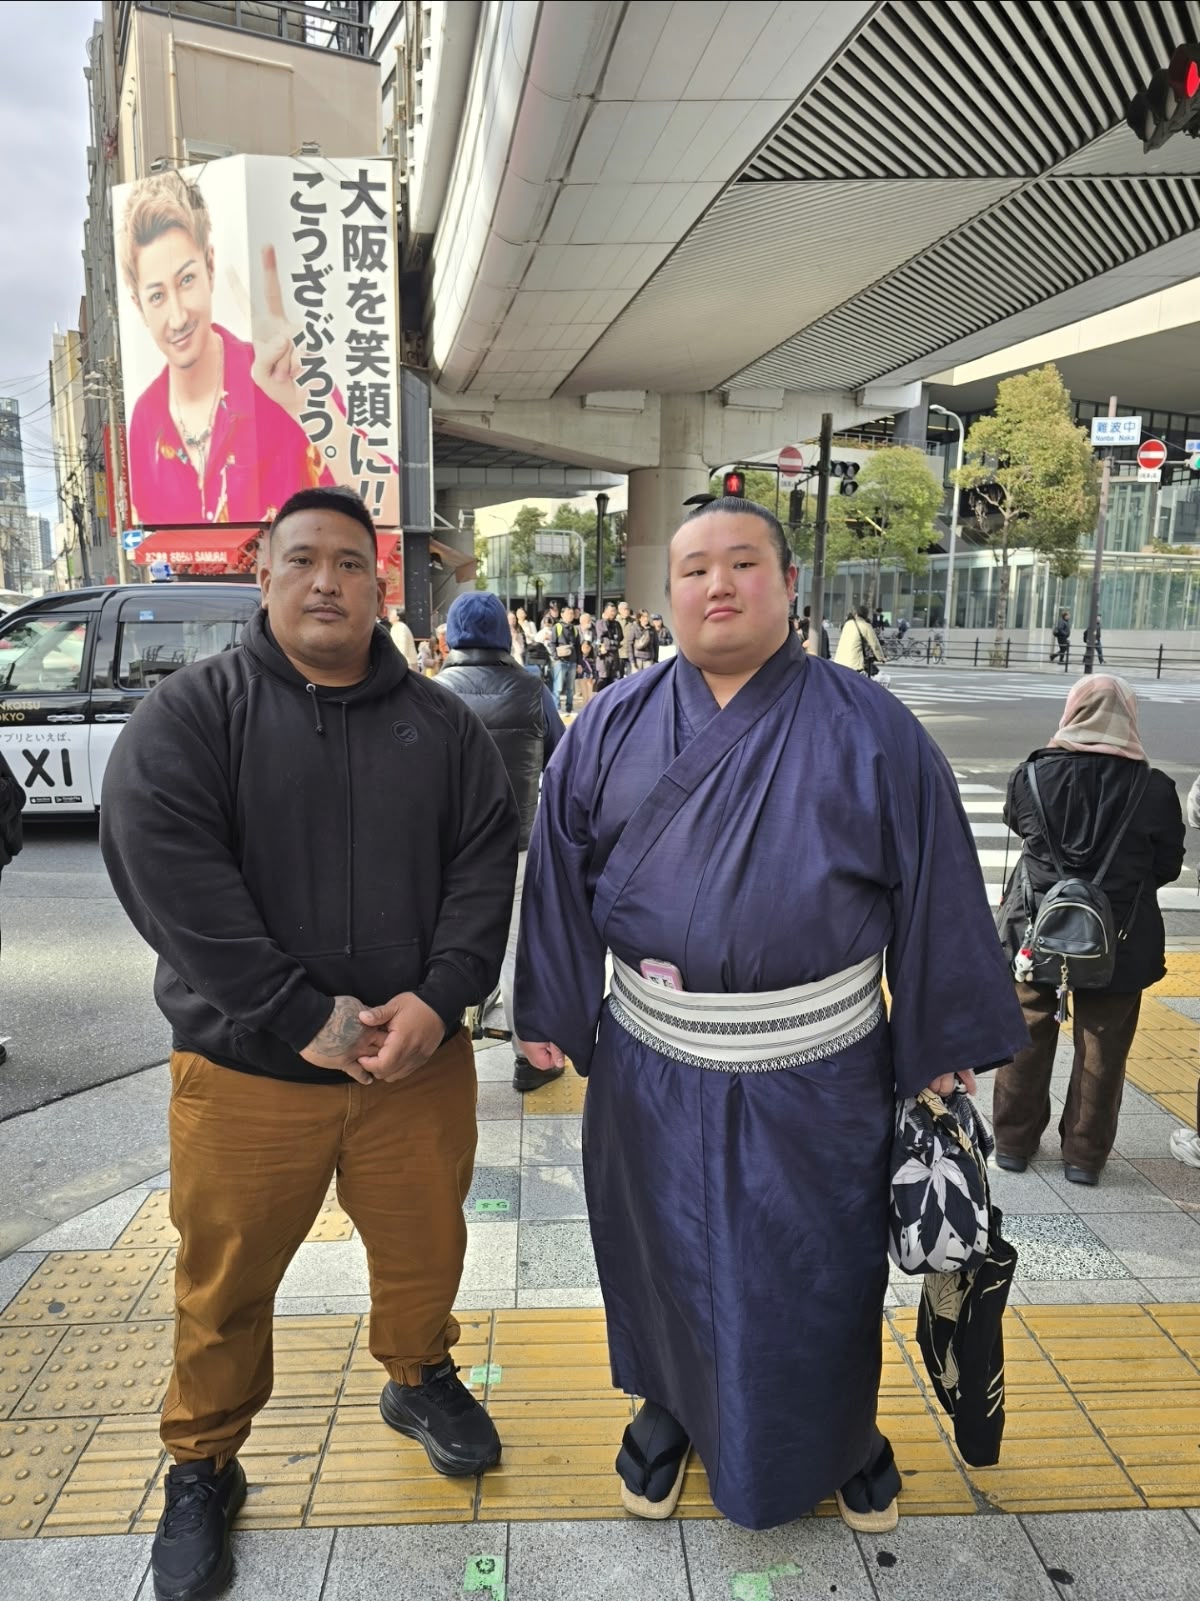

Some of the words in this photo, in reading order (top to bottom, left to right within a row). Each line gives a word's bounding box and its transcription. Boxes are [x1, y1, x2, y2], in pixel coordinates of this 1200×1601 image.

[289, 171, 337, 459] こうざぶろう。
[340, 168, 391, 517] 大阪を笑顔に!!
[1096, 421, 1136, 433] 難波中
[194, 551, 228, 563] SAMURAI
[0, 731, 72, 743] プリといえば、
